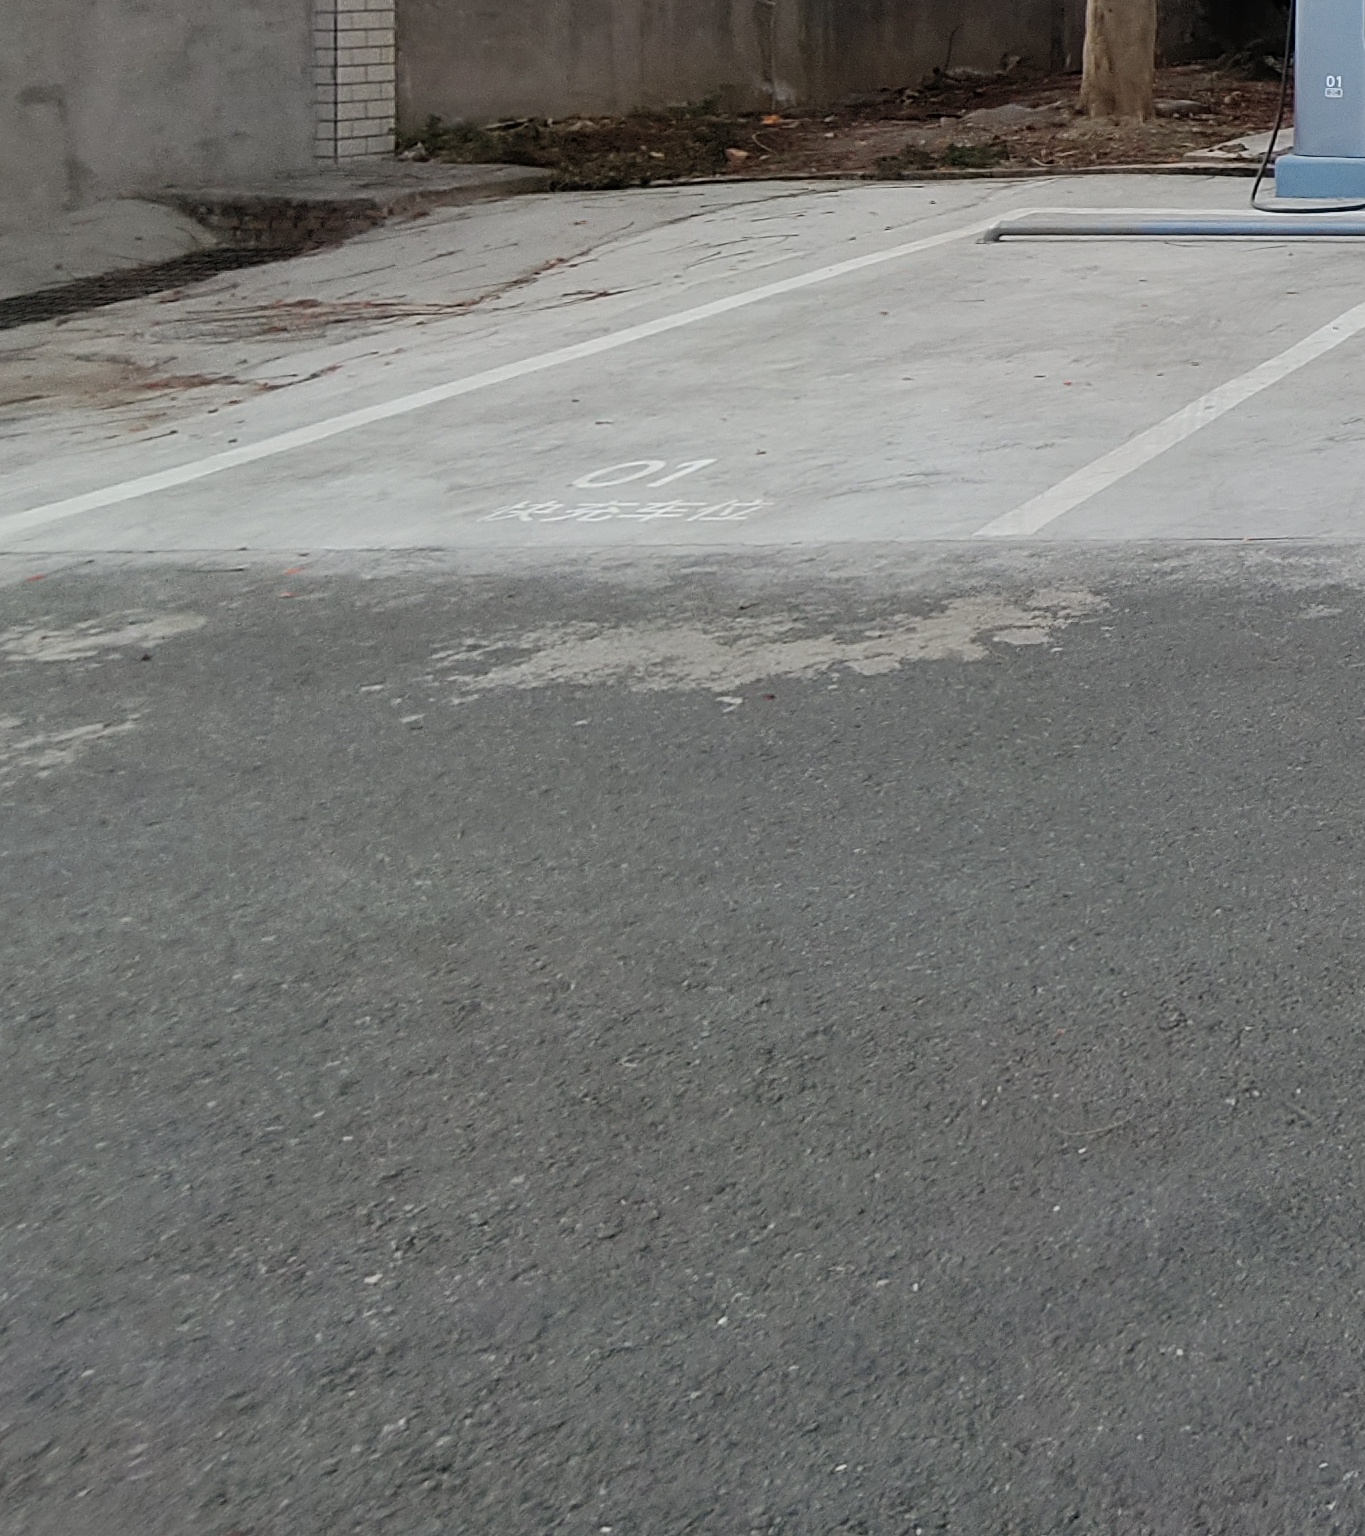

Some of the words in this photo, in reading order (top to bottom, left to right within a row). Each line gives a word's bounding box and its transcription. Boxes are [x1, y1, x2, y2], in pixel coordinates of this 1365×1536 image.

[1326, 75, 1342, 88] 01
[571, 459, 718, 488] 01
[476, 498, 774, 522] 快充车位
